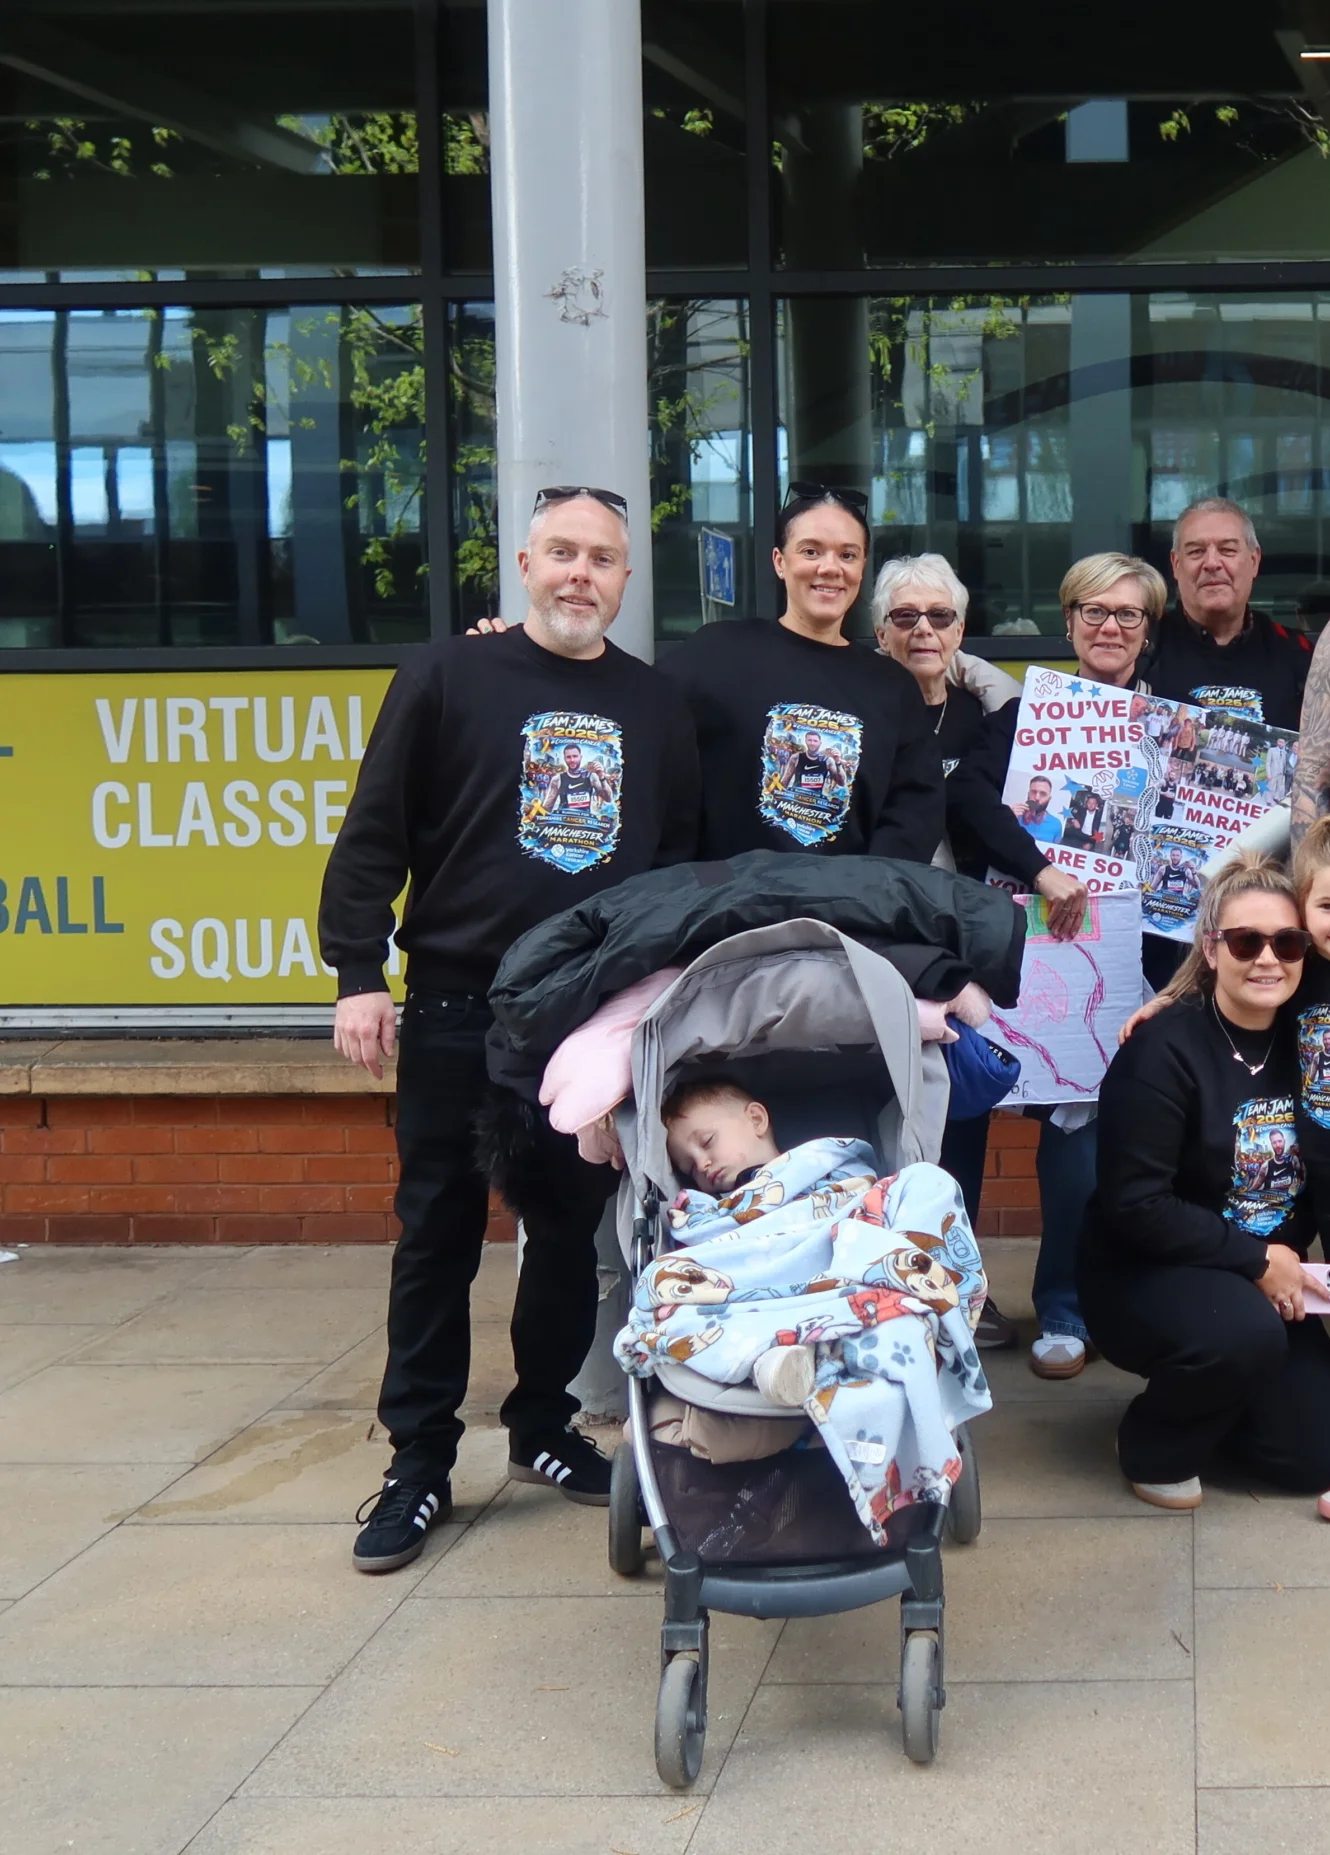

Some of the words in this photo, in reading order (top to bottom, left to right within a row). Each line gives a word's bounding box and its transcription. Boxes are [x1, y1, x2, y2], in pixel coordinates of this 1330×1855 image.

[1193, 688, 1219, 699] TEAM
[1219, 688, 1256, 701] JAMES
[1207, 698, 1243, 707] 2026
[780, 705, 811, 719] TEAM
[811, 708, 857, 727] JAMES
[1028, 700, 1128, 720] YOU'VE
[95, 695, 369, 764] VIRTUAL
[533, 713, 570, 731] TEAM
[568, 715, 615, 734] JAMES
[796, 717, 838, 730] 2026
[553, 727, 599, 741] 2026
[1017, 727, 1071, 746] GOT
[1080, 724, 1144, 744] THIS
[1032, 750, 1131, 771] JAMES!
[91, 779, 348, 849] CLASSE
[776, 801, 832, 821] MANCHESTER
[784, 811, 822, 825] MARATHON
[563, 816, 587, 824] CANCER
[538, 826, 604, 843] MANCHESTER
[550, 837, 596, 847] MARATHON
[1154, 825, 1178, 836] TEAM
[1178, 829, 1210, 843] JAMES
[1044, 847, 1088, 869] ARE
[1093, 858, 1123, 877] SO
[1086, 878, 1115, 893] OF
[1146, 900, 1192, 916] MANCHESTER
[1241, 1100, 1267, 1119] TEAM
[1267, 1099, 1294, 1116] JAM
[1256, 1114, 1295, 1124] 2026
